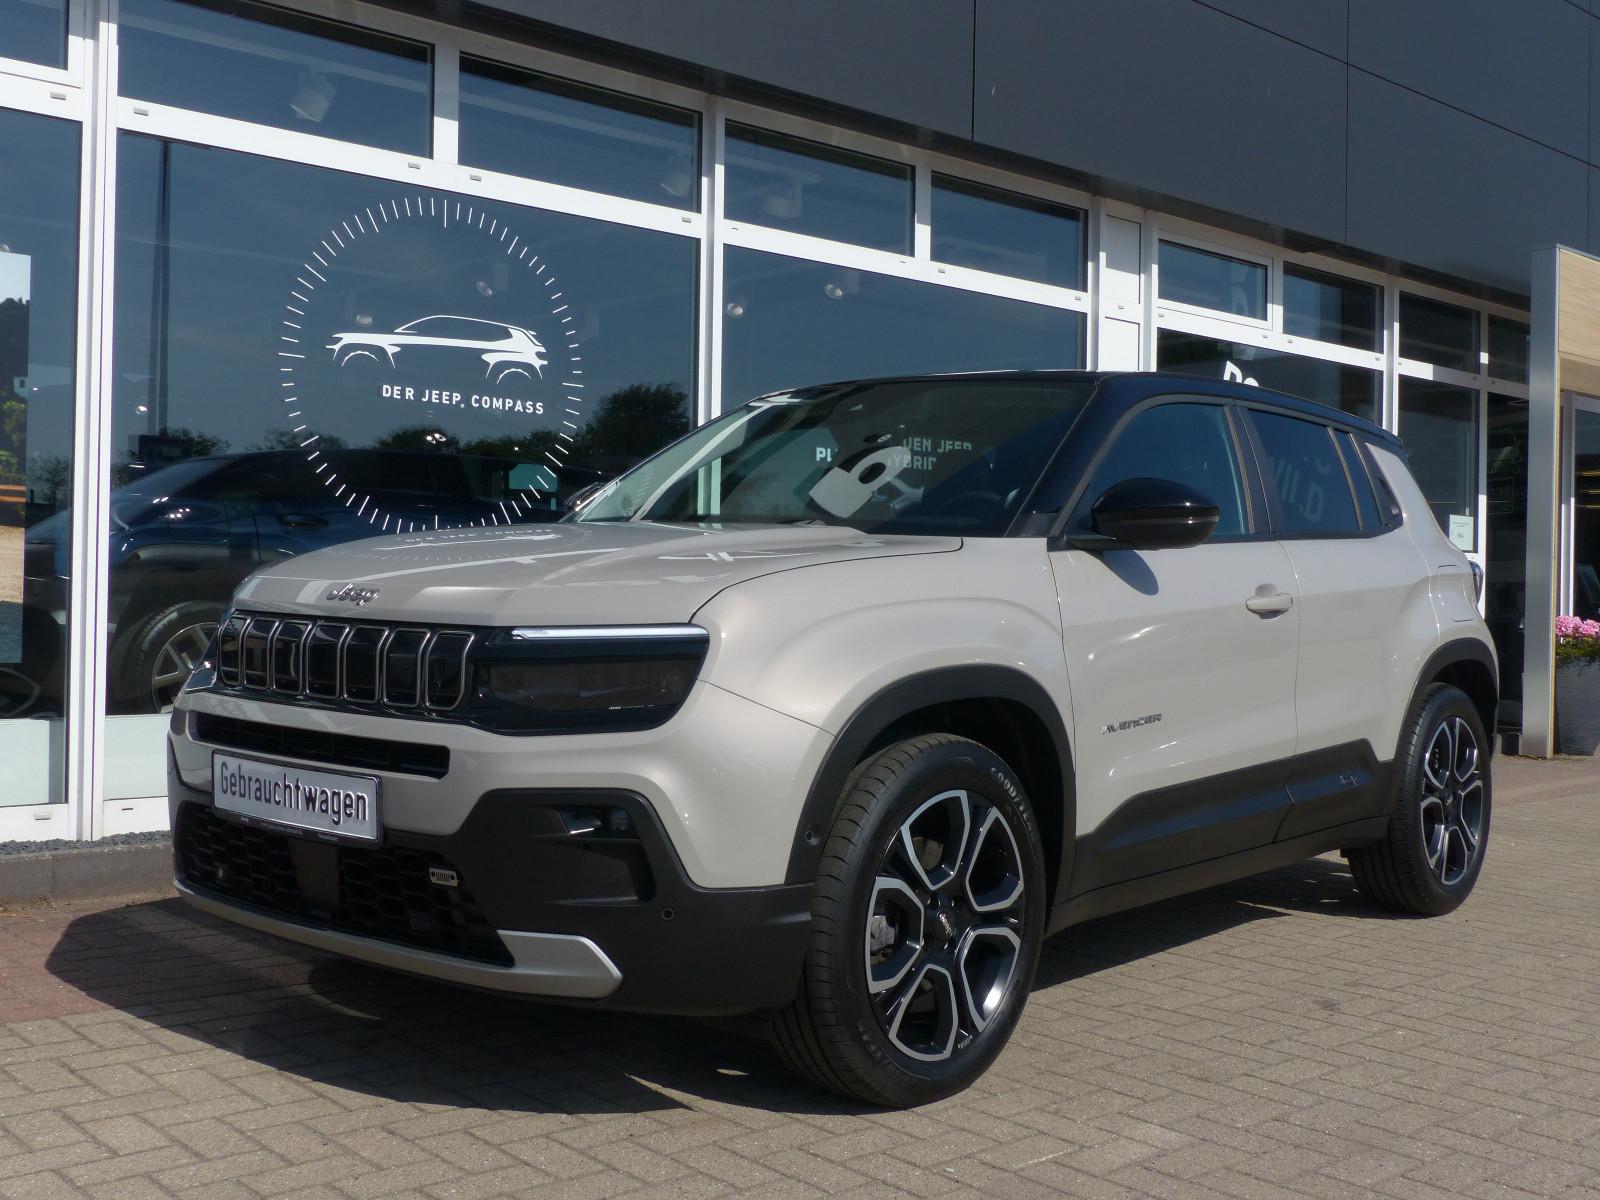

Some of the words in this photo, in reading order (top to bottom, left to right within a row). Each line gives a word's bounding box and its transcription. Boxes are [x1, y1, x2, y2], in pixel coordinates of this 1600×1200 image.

[382, 384, 415, 401] DER
[471, 395, 544, 415] COMPASS
[326, 583, 381, 607] Jeep
[220, 761, 370, 826] Gebrauchtwagen
